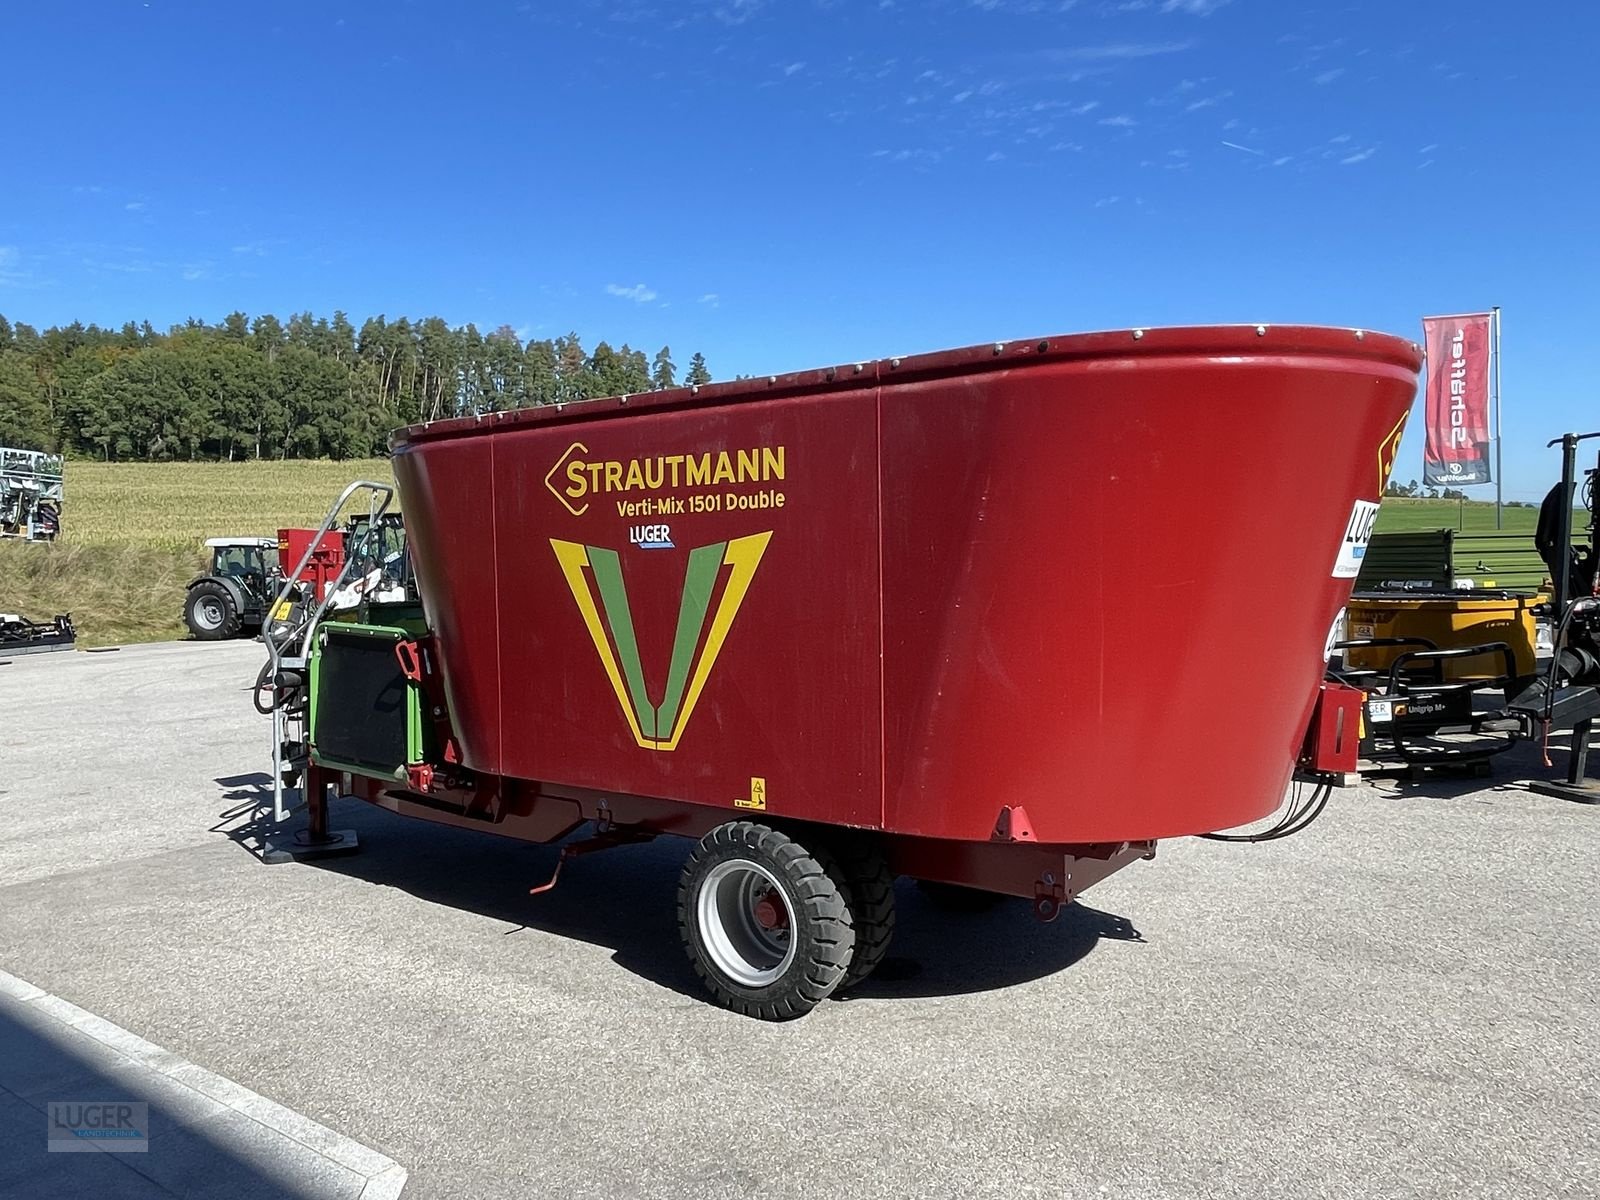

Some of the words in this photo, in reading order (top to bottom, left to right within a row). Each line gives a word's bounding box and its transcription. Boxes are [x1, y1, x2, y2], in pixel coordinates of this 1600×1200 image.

[565, 446, 785, 498] STRAUTMANN
[616, 496, 685, 517] Verti-Mix
[688, 494, 721, 513] 1501
[725, 489, 785, 511] Double
[630, 524, 671, 543] LUGER
